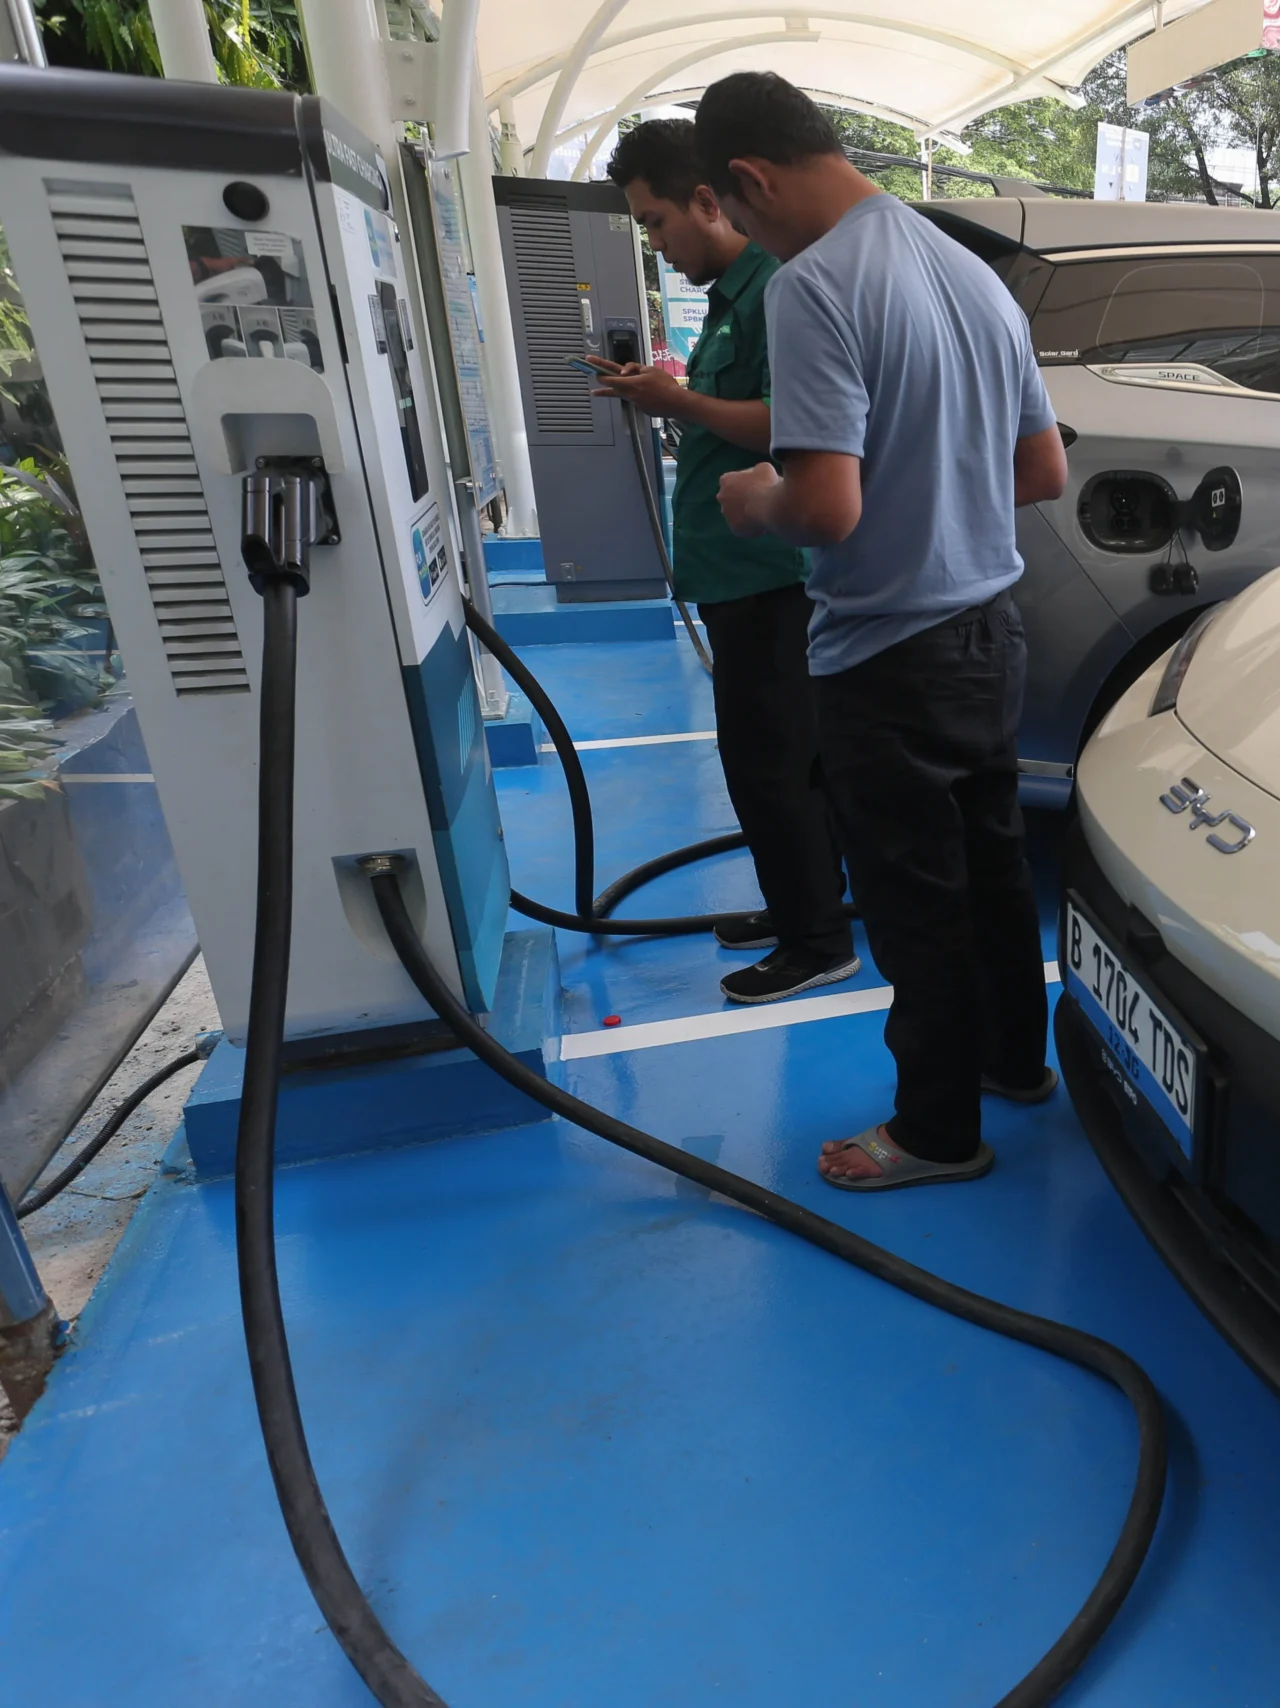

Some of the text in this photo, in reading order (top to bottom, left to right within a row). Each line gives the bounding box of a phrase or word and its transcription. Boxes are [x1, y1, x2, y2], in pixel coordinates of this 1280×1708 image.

[1158, 371, 1201, 381] SPACE
[1159, 777, 1256, 854] BYD
[1071, 914, 1190, 1116] B 1704 TDS
